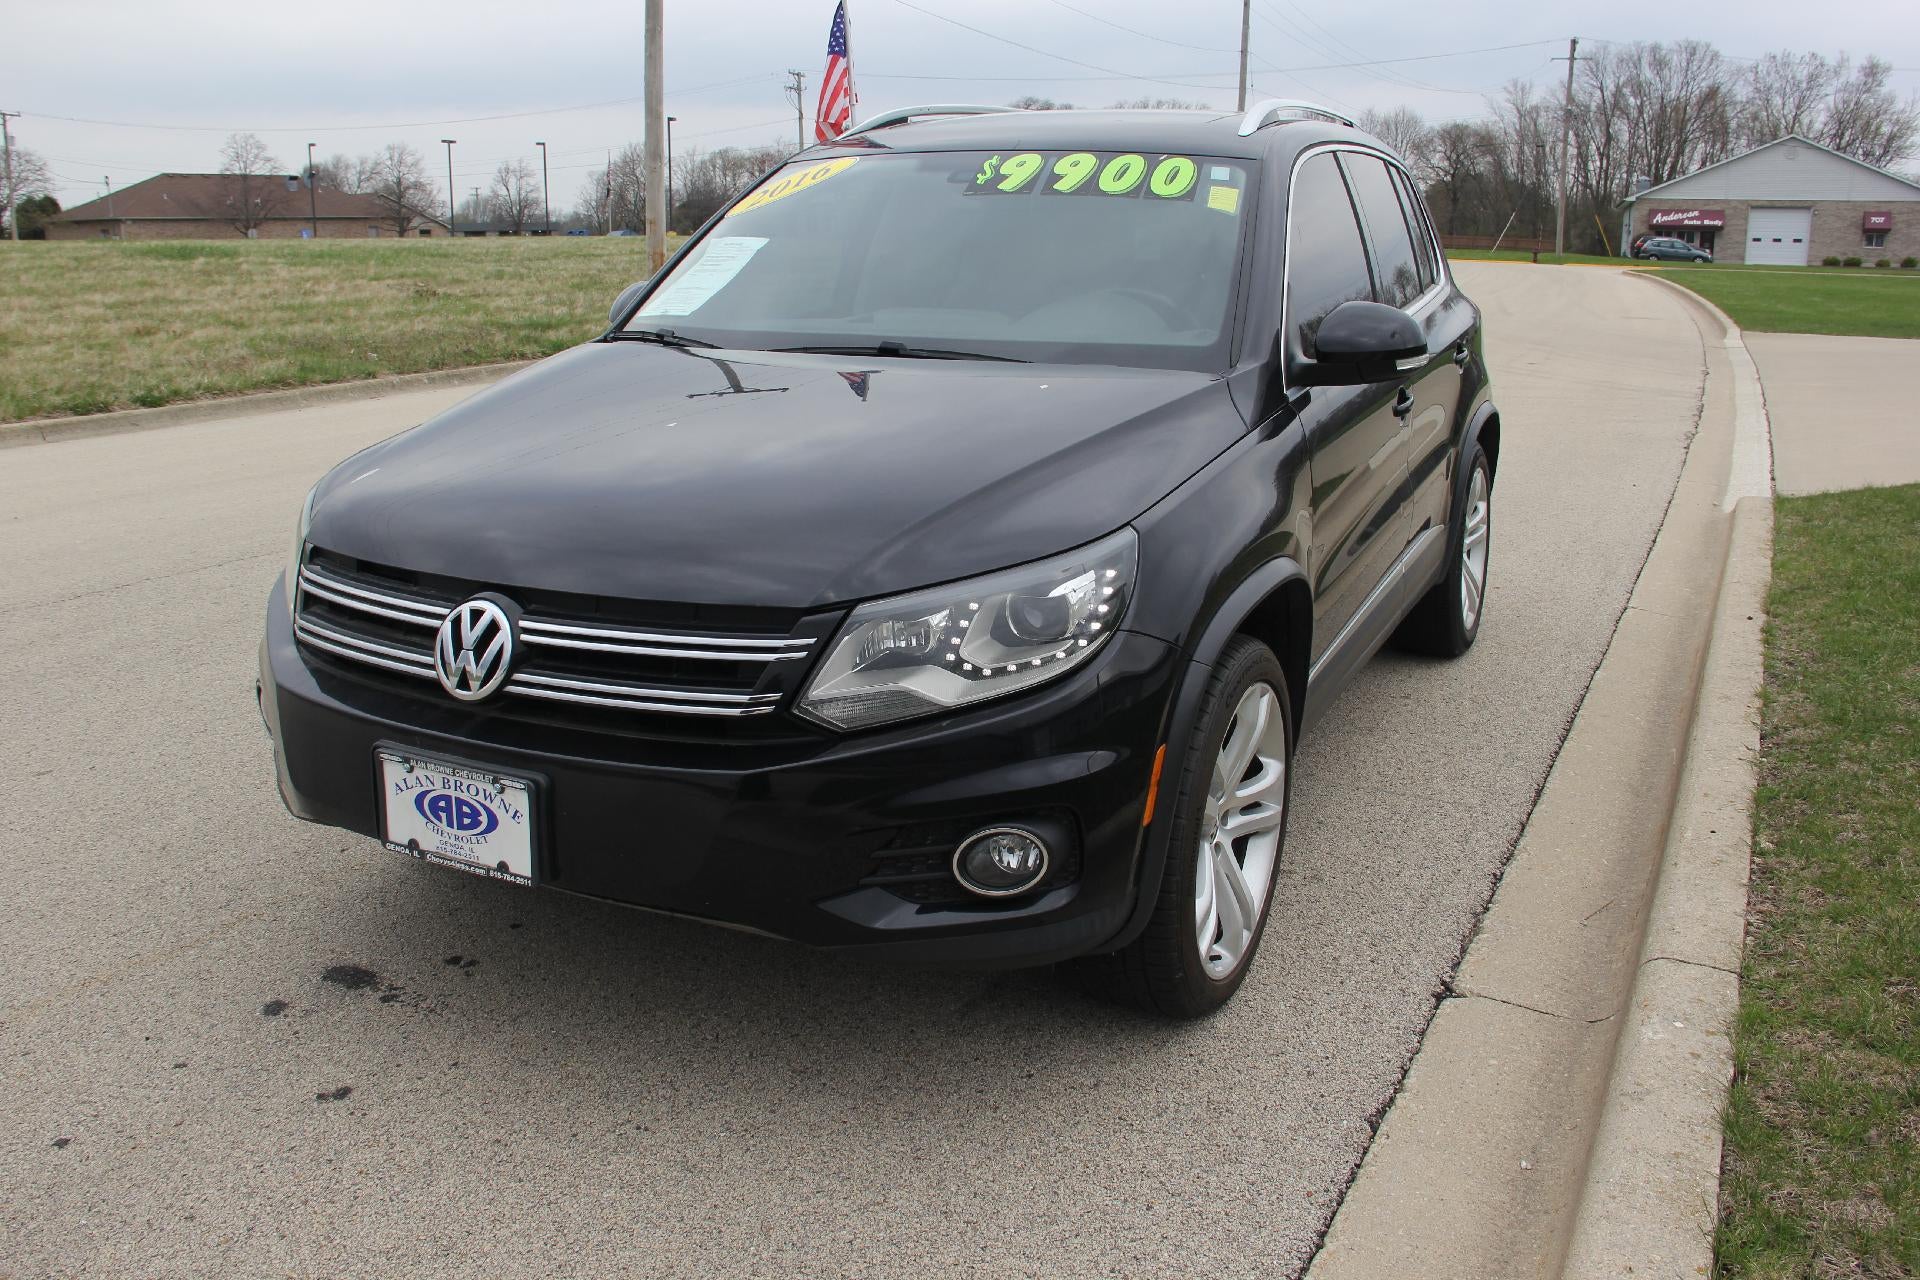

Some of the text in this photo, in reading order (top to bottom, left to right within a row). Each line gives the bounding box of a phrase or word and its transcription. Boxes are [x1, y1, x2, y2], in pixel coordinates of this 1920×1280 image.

[976, 153, 1198, 198] $9900
[1653, 210, 1700, 224] Anderson
[427, 762, 454, 775] BROWNE
[454, 768, 493, 784] CHEVROLET
[394, 774, 524, 825] ALAN BROWNE
[425, 821, 489, 845] CHEVROLET
[413, 850, 421, 858] IL
